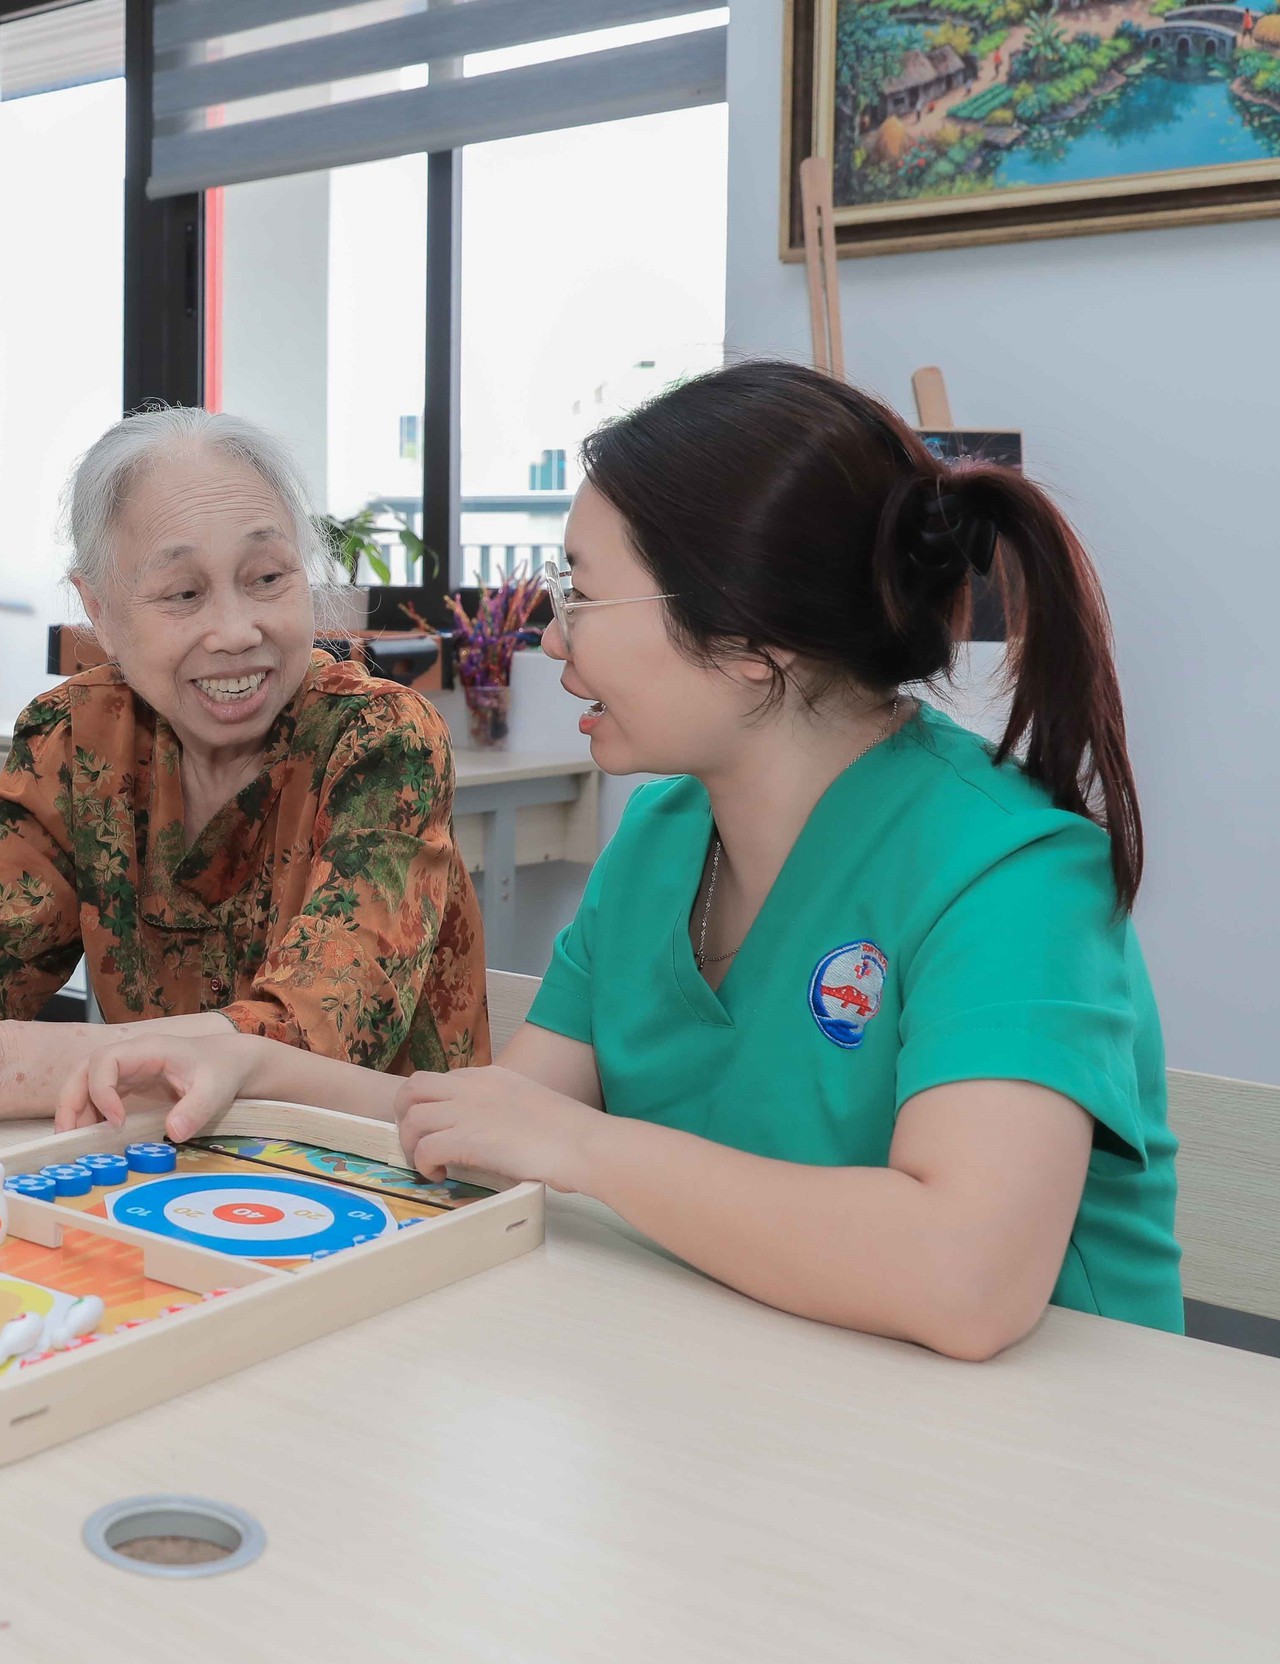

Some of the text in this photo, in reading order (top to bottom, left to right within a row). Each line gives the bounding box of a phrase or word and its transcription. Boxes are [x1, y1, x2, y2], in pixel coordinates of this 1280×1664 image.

[125, 1206, 376, 1221] 10 20 40 20 10
